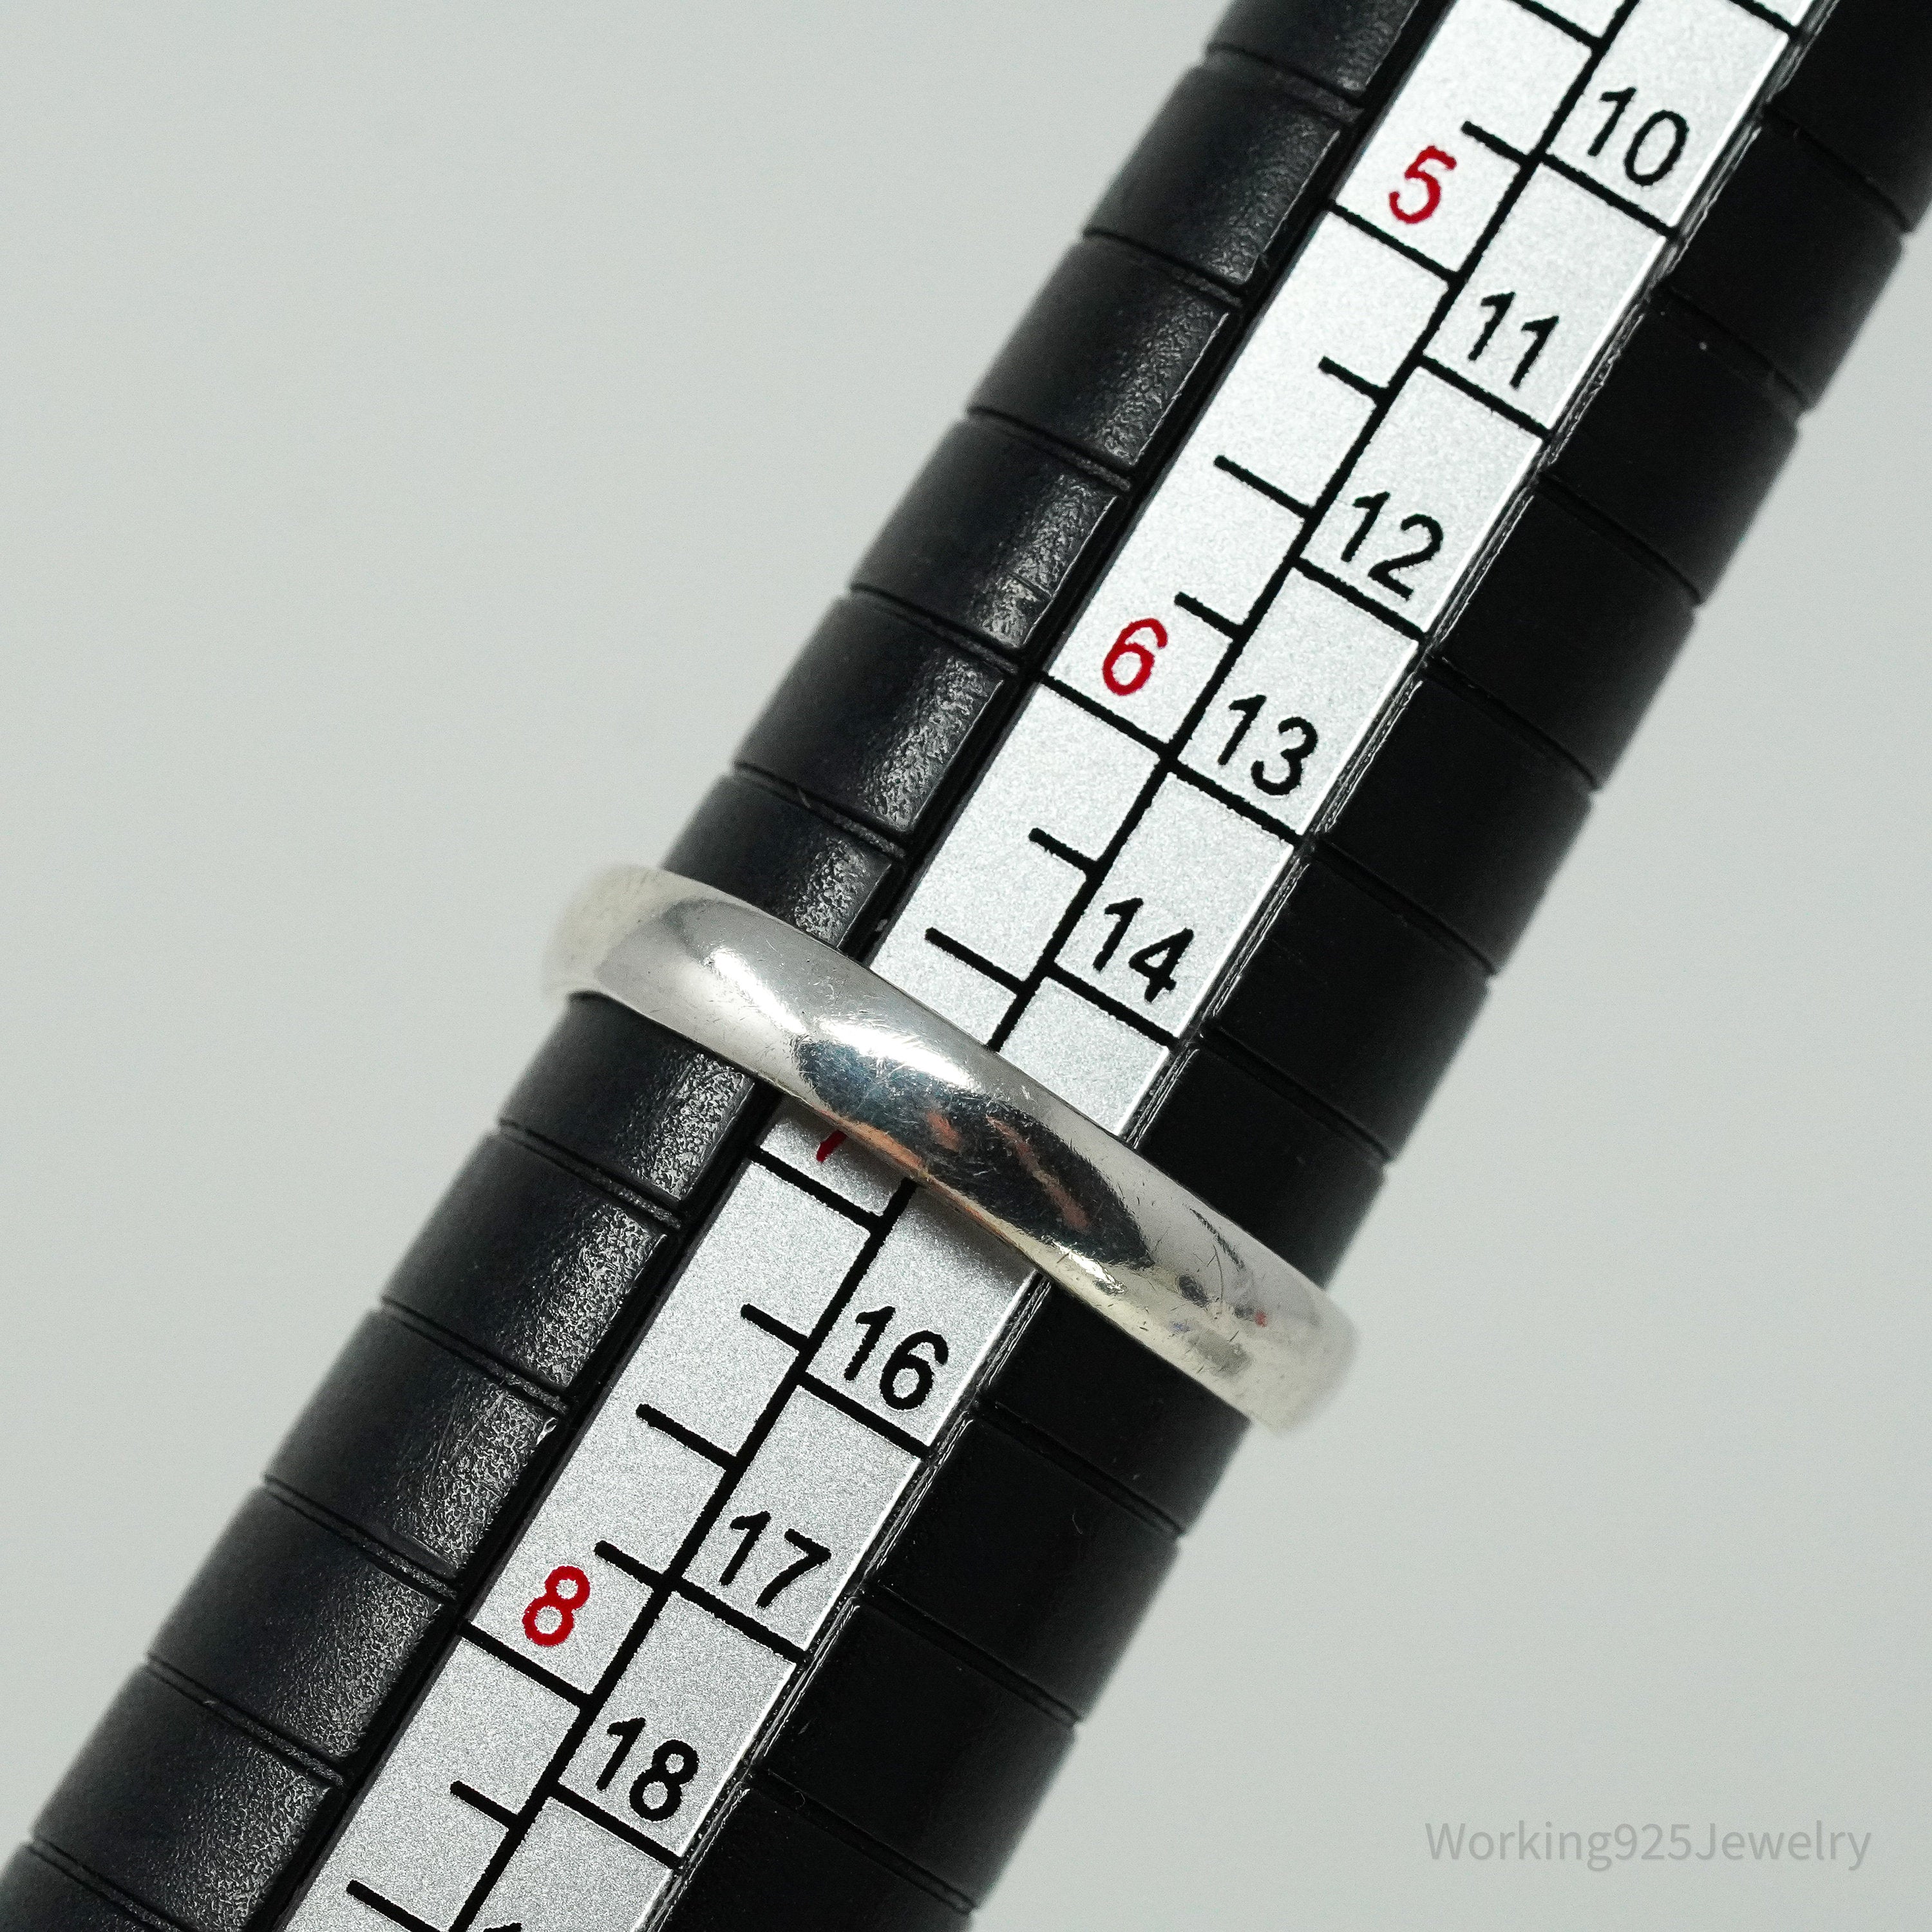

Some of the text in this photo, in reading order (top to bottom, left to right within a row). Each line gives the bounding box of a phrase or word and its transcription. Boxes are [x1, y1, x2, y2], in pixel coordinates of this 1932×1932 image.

[1390, 146, 1457, 223] 5
[1588, 88, 1689, 187] 10
[1468, 292, 1558, 389] 11
[1341, 491, 1443, 601] 12
[1103, 619, 1168, 696] 6
[1218, 695, 1318, 795] 13
[1093, 898, 1193, 1003] 14
[844, 1306, 949, 1410] 16
[522, 1566, 590, 1647] 8
[719, 1511, 831, 1611] 17
[596, 1718, 700, 1822] 18
